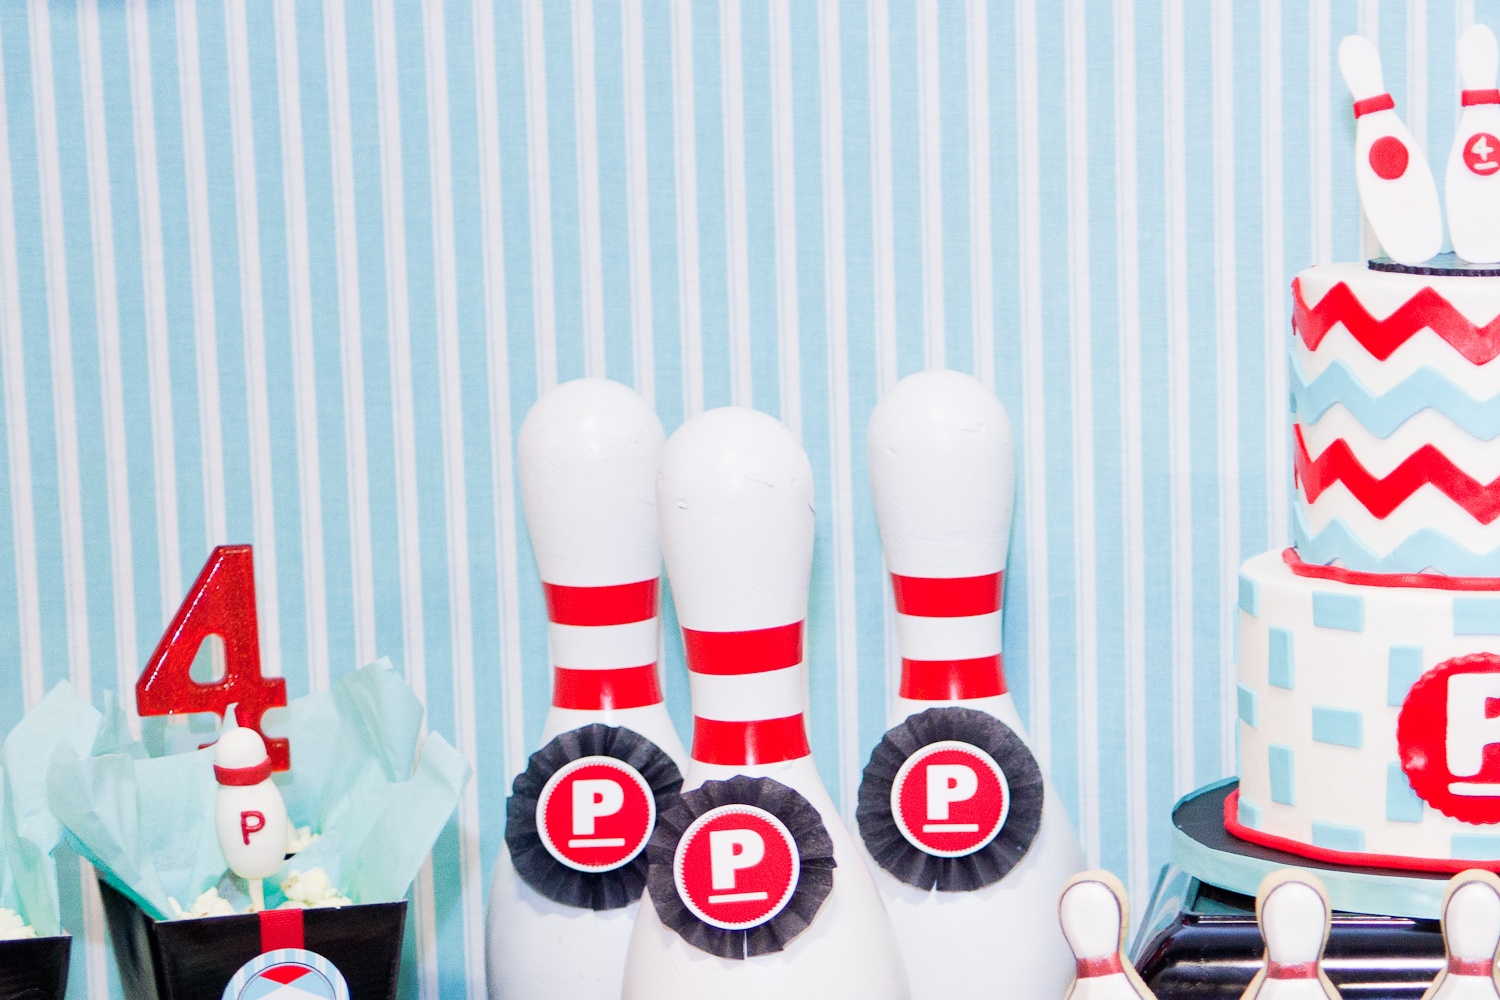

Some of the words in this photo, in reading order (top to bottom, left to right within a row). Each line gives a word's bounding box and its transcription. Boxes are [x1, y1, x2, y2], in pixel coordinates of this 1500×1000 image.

[1471, 135, 1494, 161] 4
[571, 778, 625, 836] P
[924, 764, 979, 821] P
[240, 809, 266, 846] P
[708, 828, 766, 891] P
